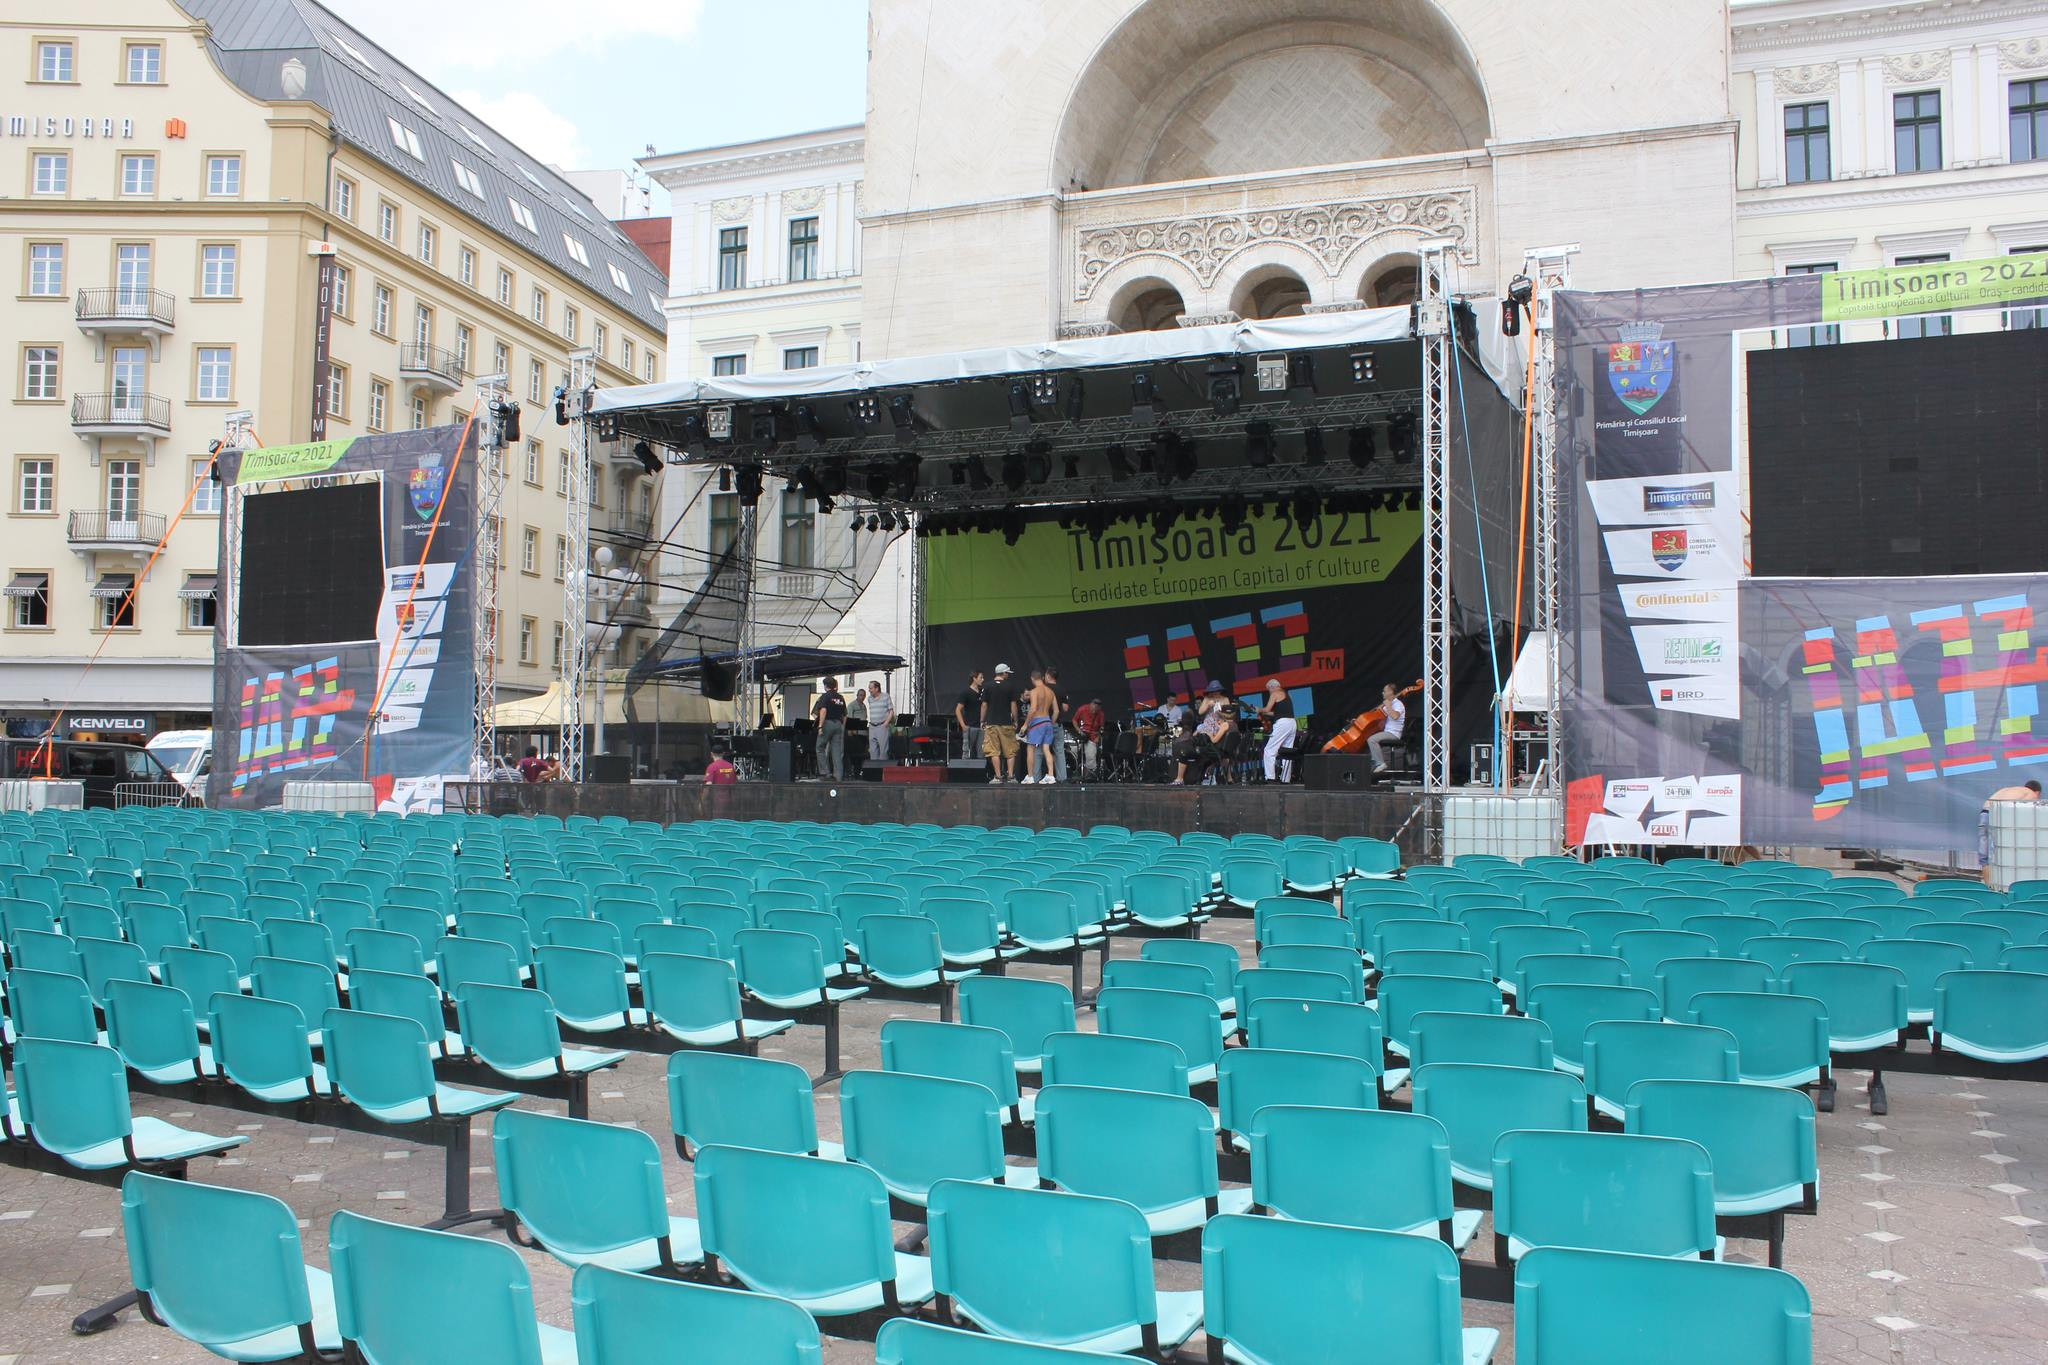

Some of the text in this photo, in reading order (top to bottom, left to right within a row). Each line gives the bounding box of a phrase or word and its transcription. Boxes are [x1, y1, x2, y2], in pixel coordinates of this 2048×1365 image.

[0, 115, 133, 138] MISOARA
[317, 267, 330, 362] HOTEL
[1634, 416, 1666, 426] Consiliul
[1667, 415, 1687, 424] Local
[302, 445, 333, 462] 2021
[1274, 511, 1381, 552] 2021
[1071, 556, 1381, 604] Candidate European Capital of Culture
[1635, 591, 1709, 608] Continental
[1663, 637, 1701, 659] RETIM
[1315, 655, 1341, 671] TM
[1677, 690, 1704, 699] BRD
[69, 717, 146, 730] KENVELO
[1652, 825, 1678, 836] ZIUA
